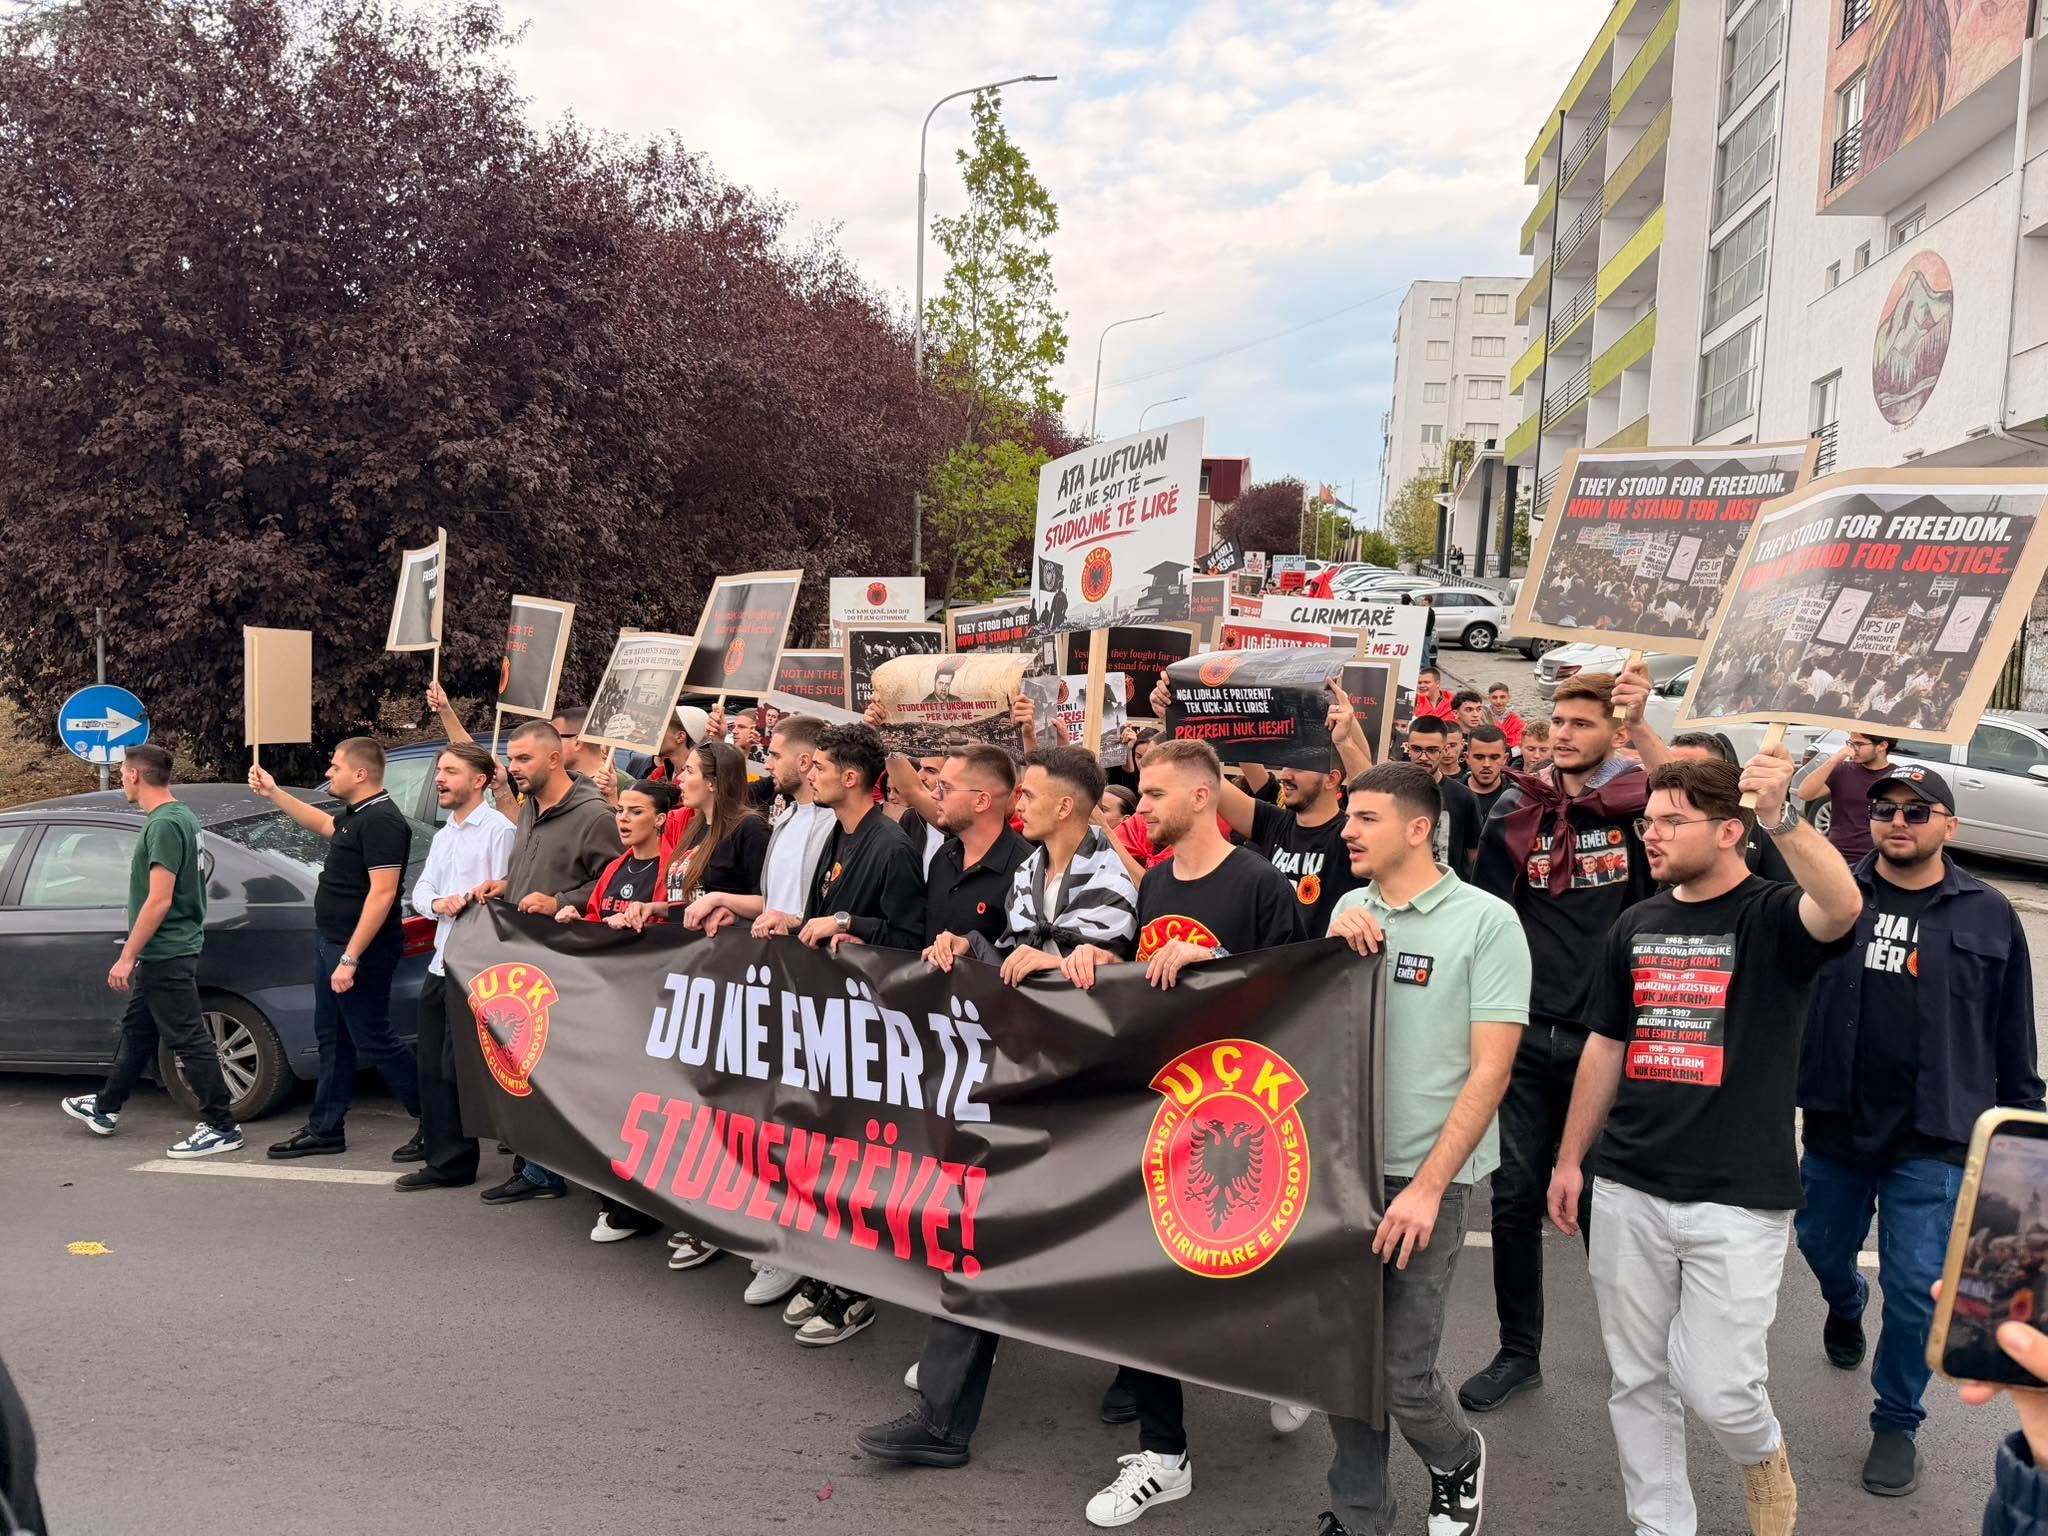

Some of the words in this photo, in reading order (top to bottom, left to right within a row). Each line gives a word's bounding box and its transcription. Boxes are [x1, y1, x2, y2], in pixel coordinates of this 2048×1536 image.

[1057, 465, 1085, 501] ATA
[1090, 432, 1169, 487] LUFTUAN
[1578, 477, 1616, 497] THEY
[1618, 476, 1667, 497] STOOD
[1669, 474, 1704, 497] FOR
[1707, 472, 1785, 496] FREEDOM.
[1069, 493, 1083, 515] QË
[1084, 489, 1099, 511] NE
[1102, 479, 1125, 503] SOT
[1127, 472, 1142, 493] TË
[1567, 498, 1605, 518] NOW
[1606, 498, 1630, 520] WE
[1632, 499, 1684, 520] STAND
[1686, 499, 1720, 521] FOR
[1720, 498, 1777, 521] JUST
[1044, 503, 1113, 552] STUDIOJMË
[1117, 495, 1136, 528] TË
[1140, 483, 1180, 523] LIRË
[1755, 535, 1788, 562] THEY
[1787, 517, 1834, 550] STOOD
[1835, 514, 1884, 539] FOR
[1885, 515, 2012, 542] FREEDOM.
[1712, 562, 1722, 571] UP
[1797, 543, 1850, 574] STAND
[1850, 543, 1902, 569] FOR
[1902, 546, 2010, 575] JUSTICE.
[1290, 606, 1396, 627] CLIRIMTARË
[958, 623, 976, 635] THEY
[978, 619, 1001, 632] STOOD
[1002, 616, 1014, 628] FOR
[1860, 620, 1882, 632] UPS
[1884, 621, 1901, 634] UP
[976, 632, 987, 645] WE
[1111, 648, 1127, 660] they
[1129, 648, 1156, 661] fought
[1158, 649, 1169, 661] for
[1372, 643, 1391, 656] ME
[1392, 644, 1409, 656] JU
[781, 669, 802, 679] NOT
[803, 669, 815, 679] IN
[816, 669, 837, 680] THE
[1114, 661, 1136, 670] stand
[1138, 661, 1151, 671] for
[1152, 663, 1166, 673] the
[794, 684, 814, 695] THE
[816, 685, 846, 696] STUD
[1176, 689, 1192, 701] NGA
[1193, 688, 1222, 701] LIDHJA
[1223, 688, 1229, 700] E
[897, 703, 938, 712] STUDENTET
[940, 703, 945, 711] E
[947, 701, 974, 711] UKSHIN
[975, 701, 998, 710] HOTIT
[1057, 704, 1074, 712] RENI
[1185, 702, 1201, 714] TEK
[1202, 701, 1235, 714] UÇK-JA
[1236, 701, 1241, 712] E
[1363, 696, 1378, 705] us.
[1175, 722, 1230, 740] PRIZRENI
[1233, 721, 1256, 736] NUK
[1258, 717, 1296, 736] HESHT!
[1582, 829, 1608, 849] EMËR
[1654, 946, 1688, 957] KOSOVA
[1400, 954, 1418, 967] LIRIA
[1418, 957, 1428, 969] KA
[1638, 955, 1657, 966] NUK
[1690, 956, 1721, 968] KRIM!
[1397, 966, 1416, 980] EMËR
[477, 966, 552, 1010] UÇK
[1679, 993, 1712, 1005] KRIM!
[1674, 1019, 1712, 1030] POPULLIT
[1679, 1029, 1707, 1042] KRIM!
[646, 972, 716, 1067] JO
[714, 964, 772, 1081] NË
[781, 977, 924, 1110] EMËR
[928, 994, 991, 1123] TË
[1633, 1054, 1653, 1065] LUFTA
[1654, 1054, 1669, 1065] PËR
[1671, 1057, 1704, 1069] ÇLIRIM
[1162, 1045, 1294, 1114] UÇK
[1634, 1066, 1649, 1077] NUK
[1672, 1068, 1704, 1082] KRIM!
[1151, 1111, 1178, 1209] USHTRIA
[1270, 1119, 1302, 1233] KOSOVËS
[610, 1091, 988, 1281] STUDENTËVE!
[1160, 1211, 1259, 1267] ÇLIRIMTARE
[1258, 1231, 1274, 1248] E
